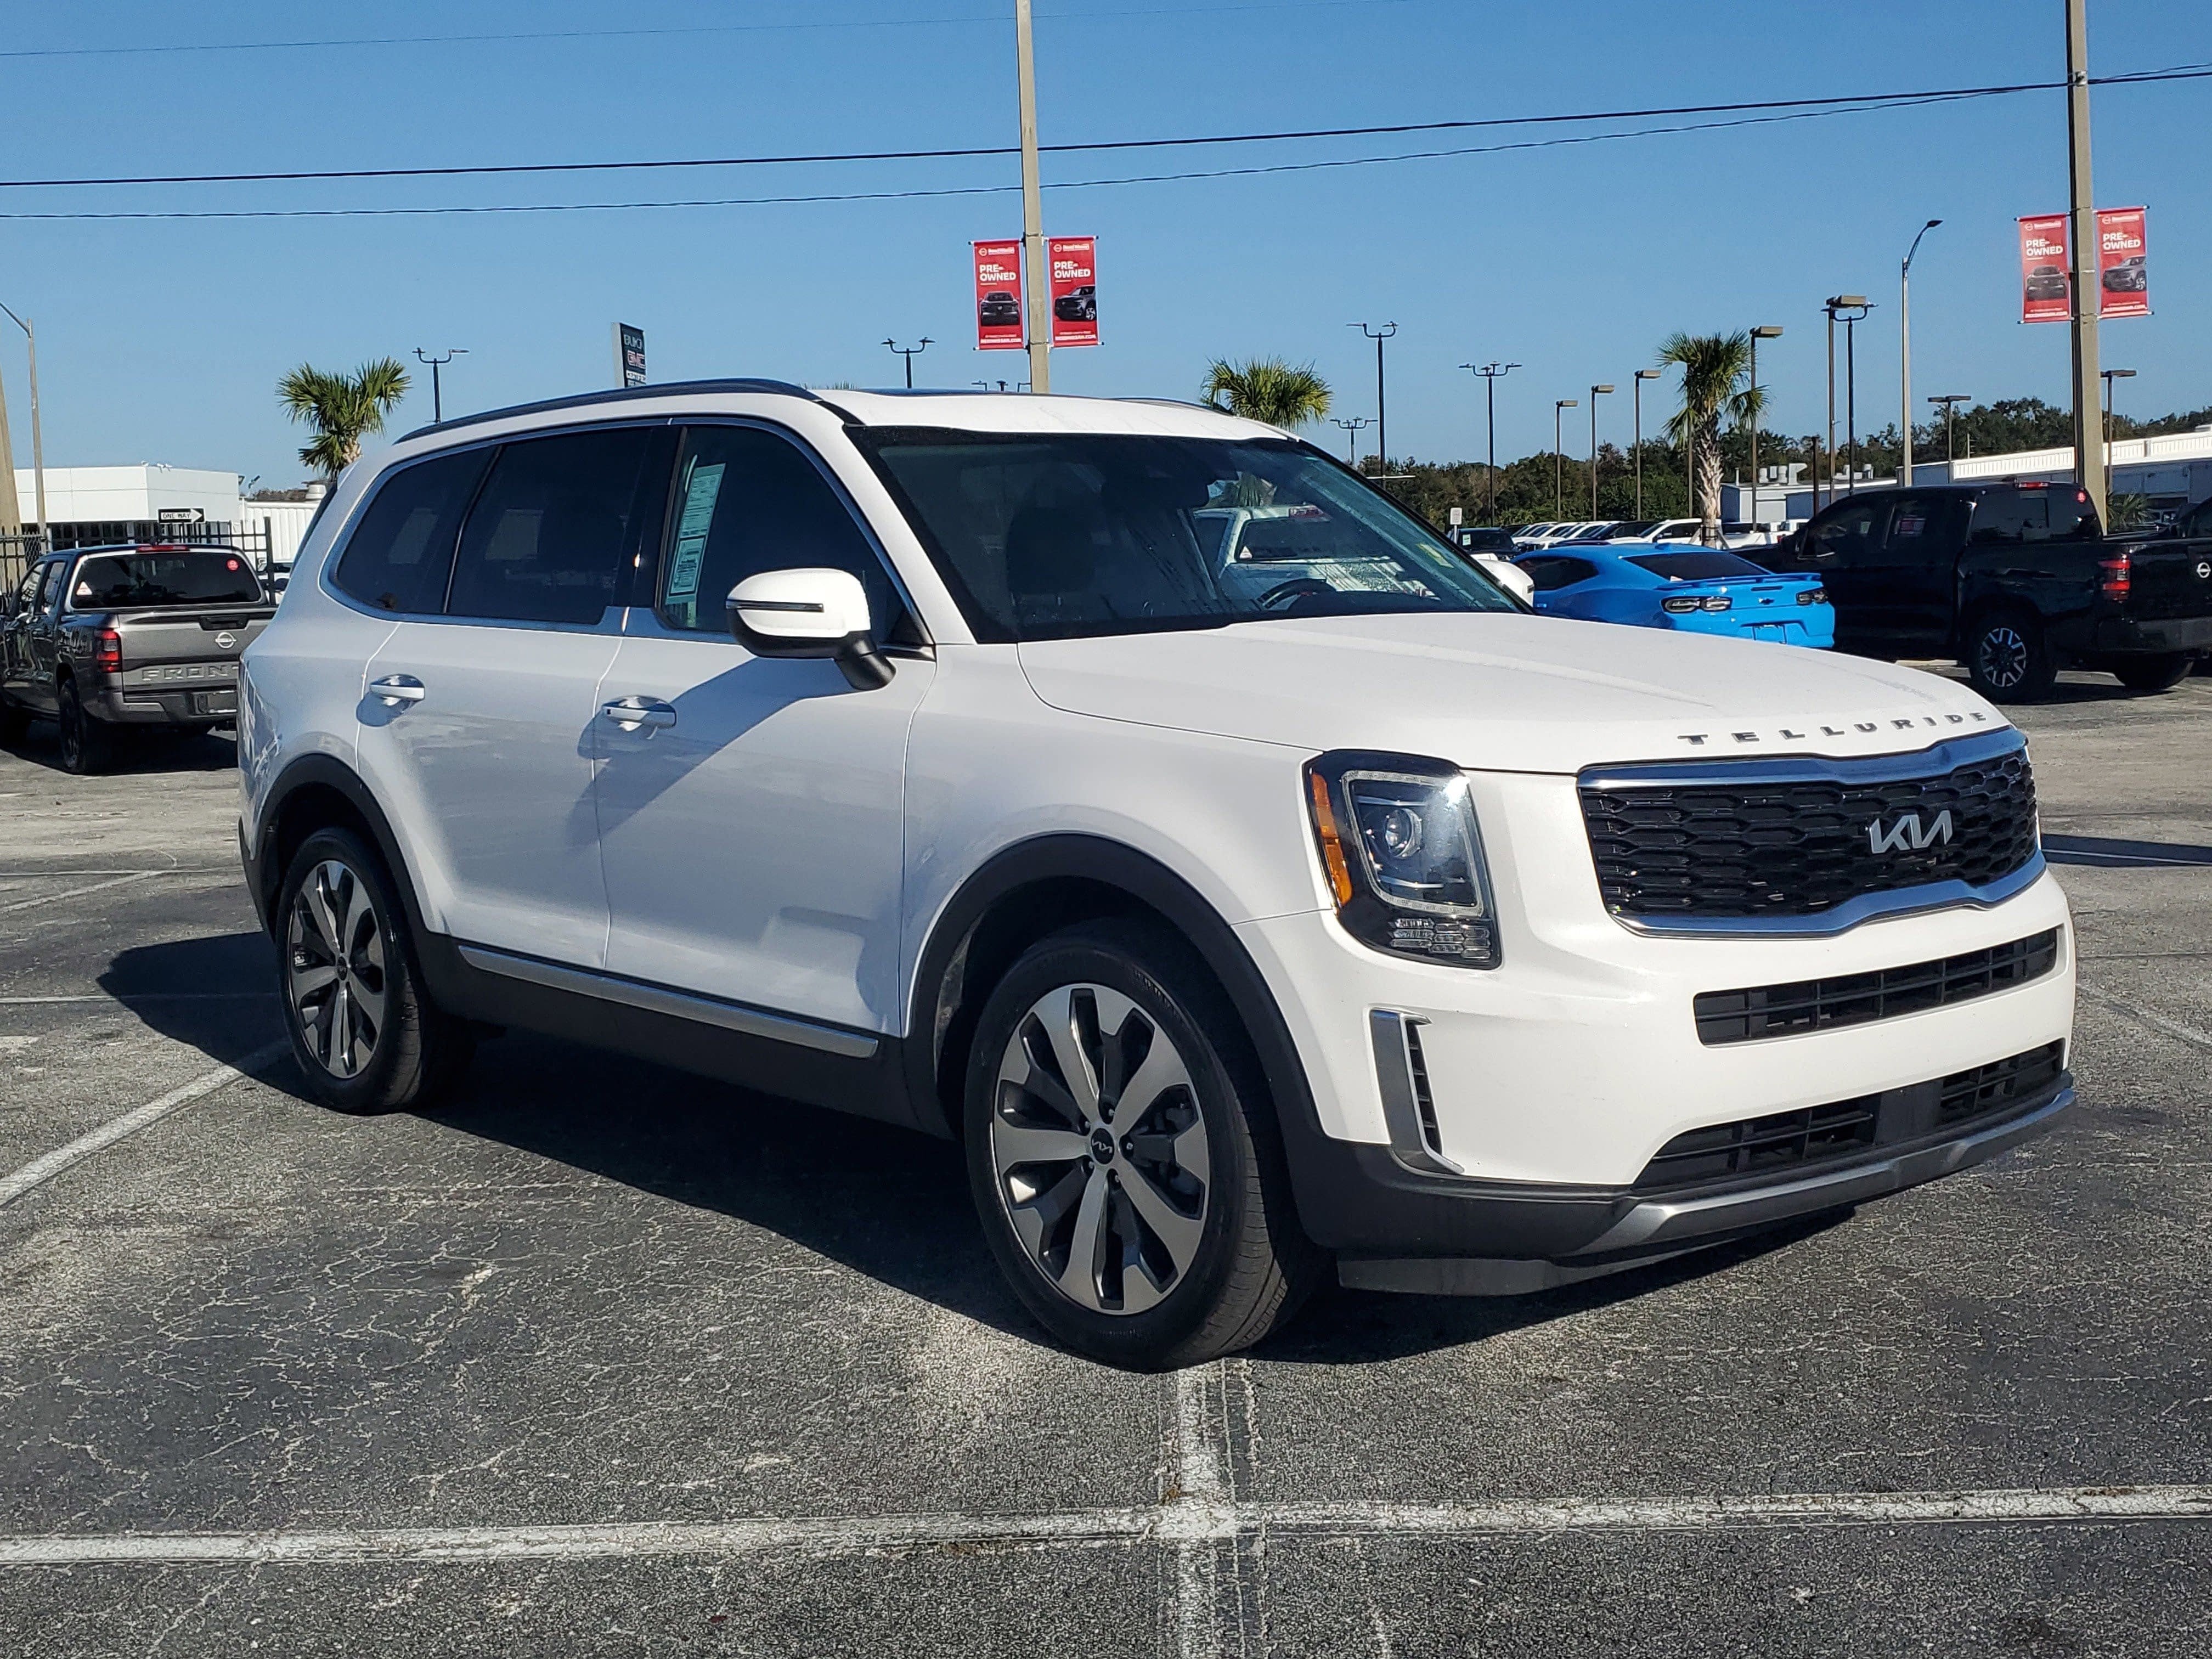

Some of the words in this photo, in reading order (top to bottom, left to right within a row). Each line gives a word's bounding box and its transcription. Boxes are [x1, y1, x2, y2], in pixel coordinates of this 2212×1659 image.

[2103, 233, 2128, 241] PRE-
[2025, 239, 2050, 248] PRE-
[2103, 240, 2141, 250] OWNED
[2026, 246, 2063, 256] OWNED
[979, 264, 1004, 273] PRE-
[1054, 261, 1079, 270] PRE-
[979, 272, 1017, 281] OWNED
[1054, 269, 1091, 279] OWNED
[1677, 712, 1987, 746] TELLURIDE
